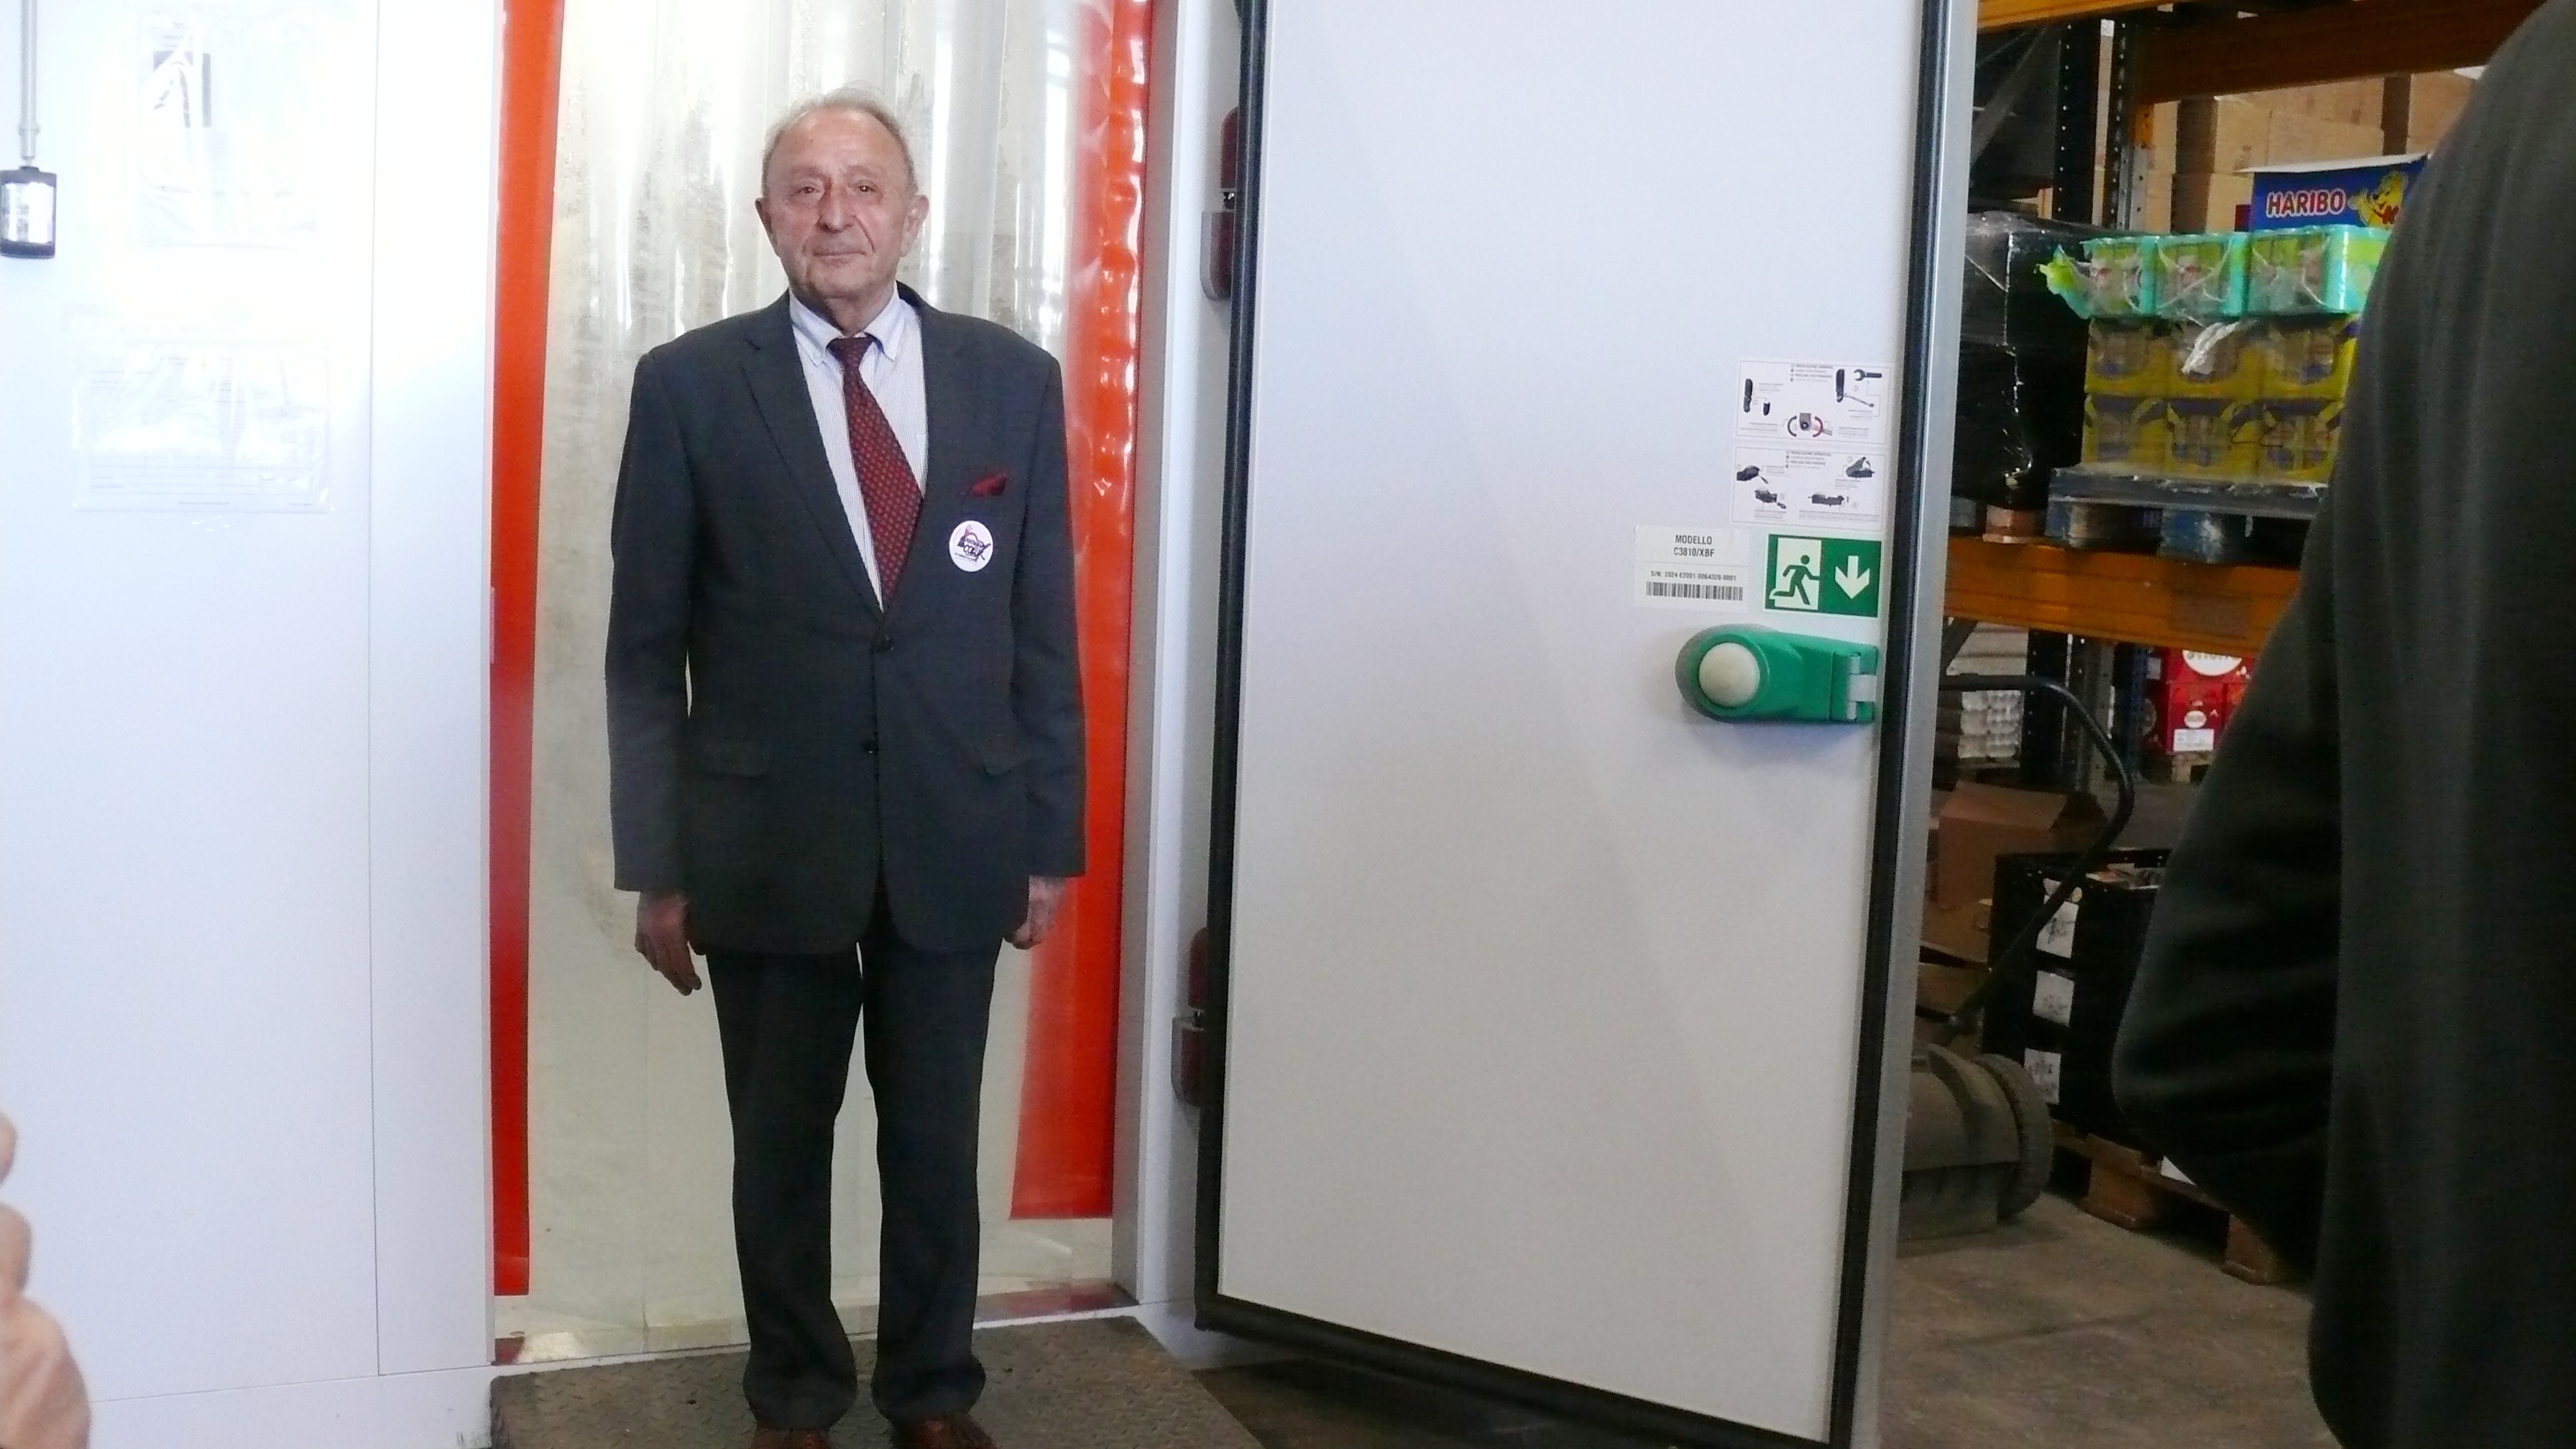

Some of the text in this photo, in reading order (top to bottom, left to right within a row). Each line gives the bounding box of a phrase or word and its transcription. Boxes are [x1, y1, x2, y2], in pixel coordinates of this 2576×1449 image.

[2266, 188, 2346, 218] HARIBO
[1675, 535, 1712, 545] MODELLO
[1674, 548, 1715, 557] C3810/XBF
